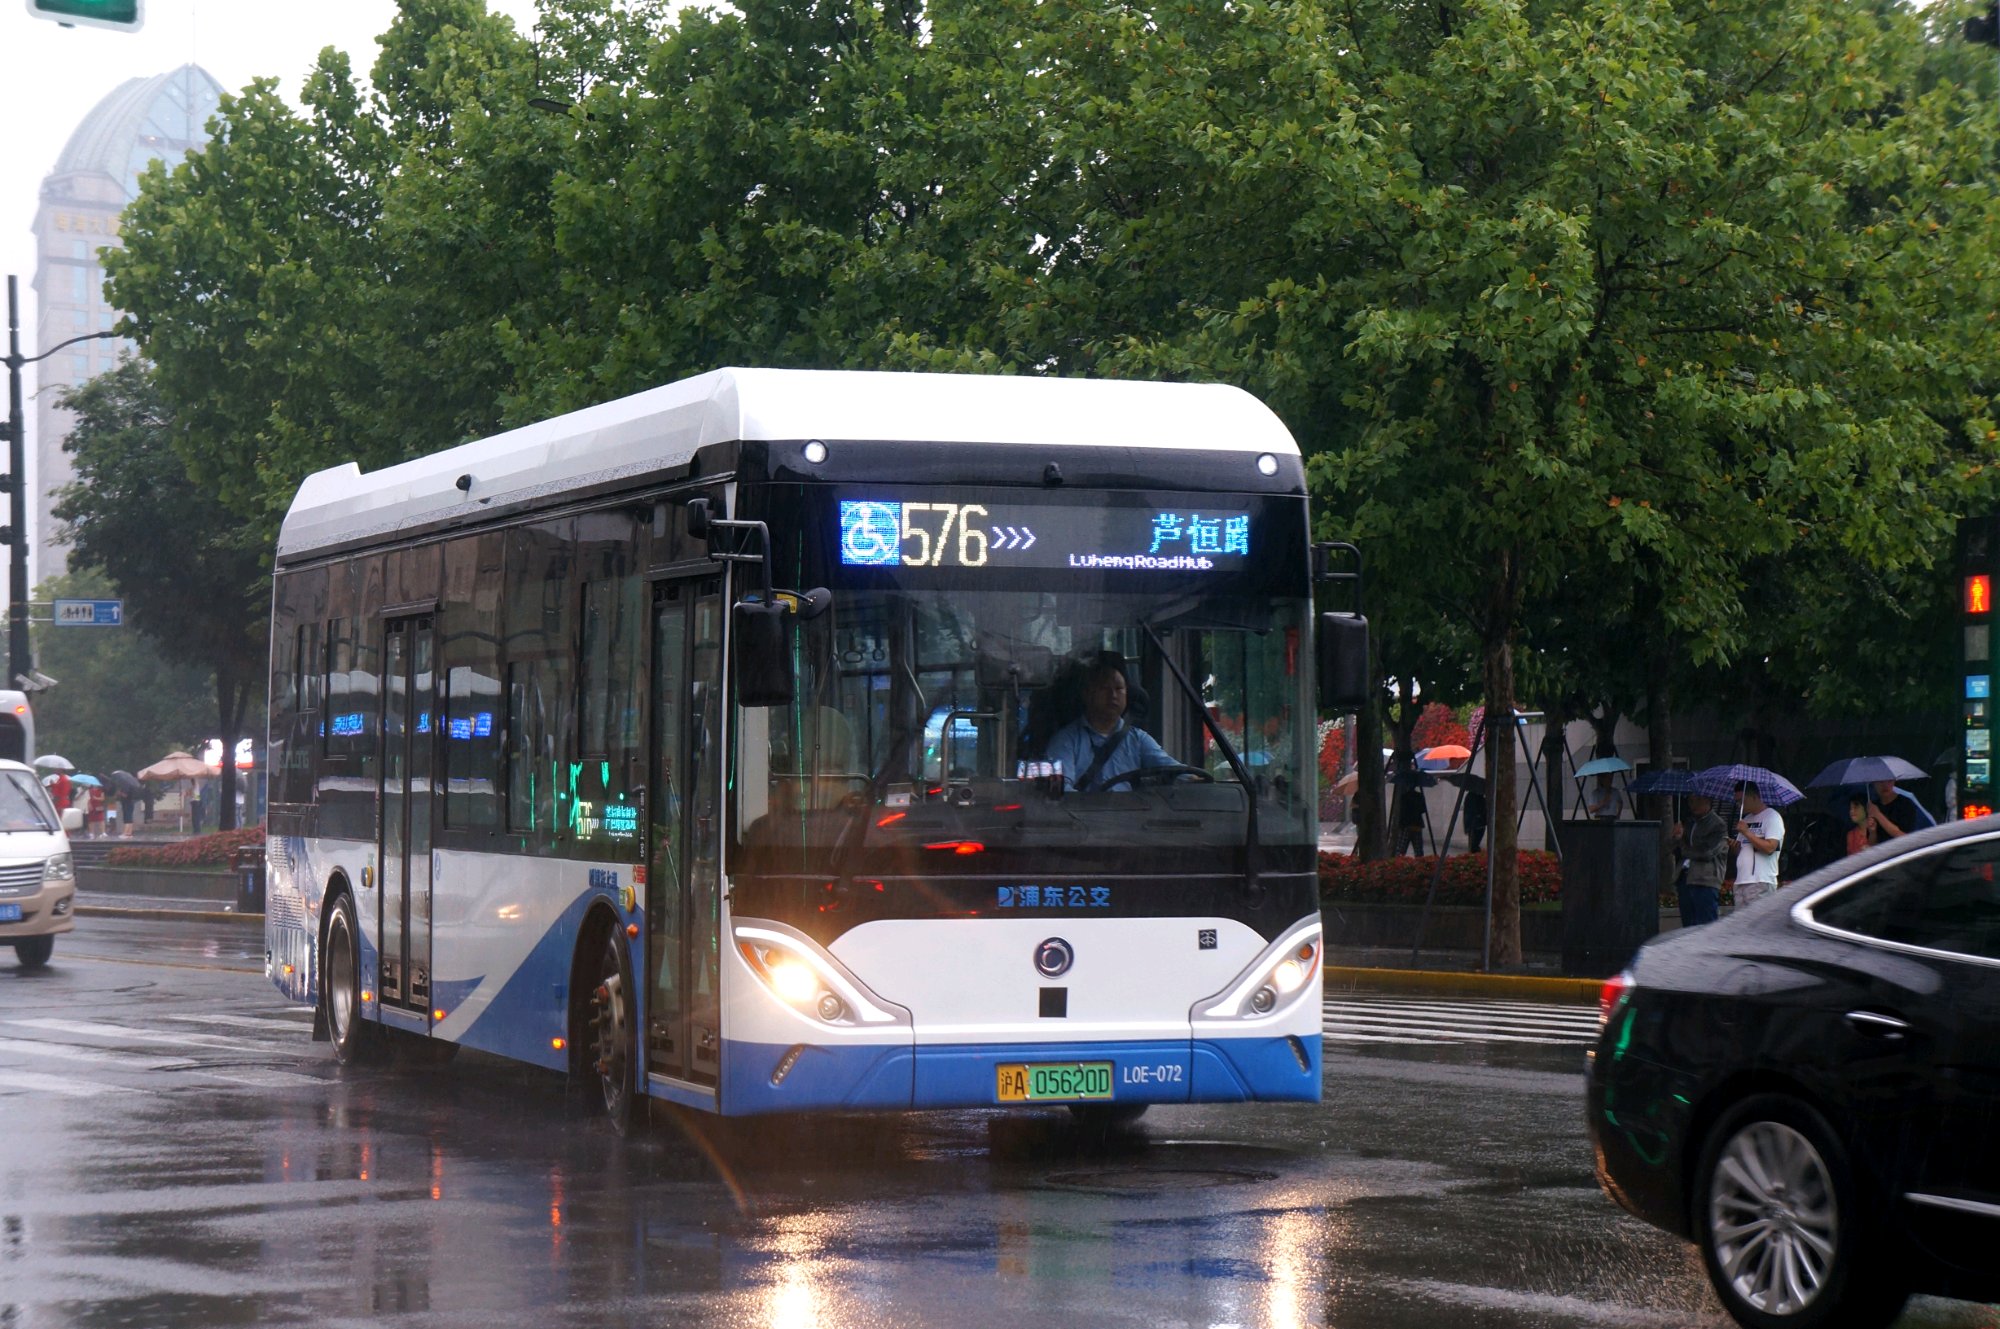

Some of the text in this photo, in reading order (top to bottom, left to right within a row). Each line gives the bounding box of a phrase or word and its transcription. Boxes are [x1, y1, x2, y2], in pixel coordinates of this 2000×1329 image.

[901, 503, 988, 566] 576
[1018, 885, 1110, 907] 浦东公交
[1035, 1068, 1110, 1095] 05620D
